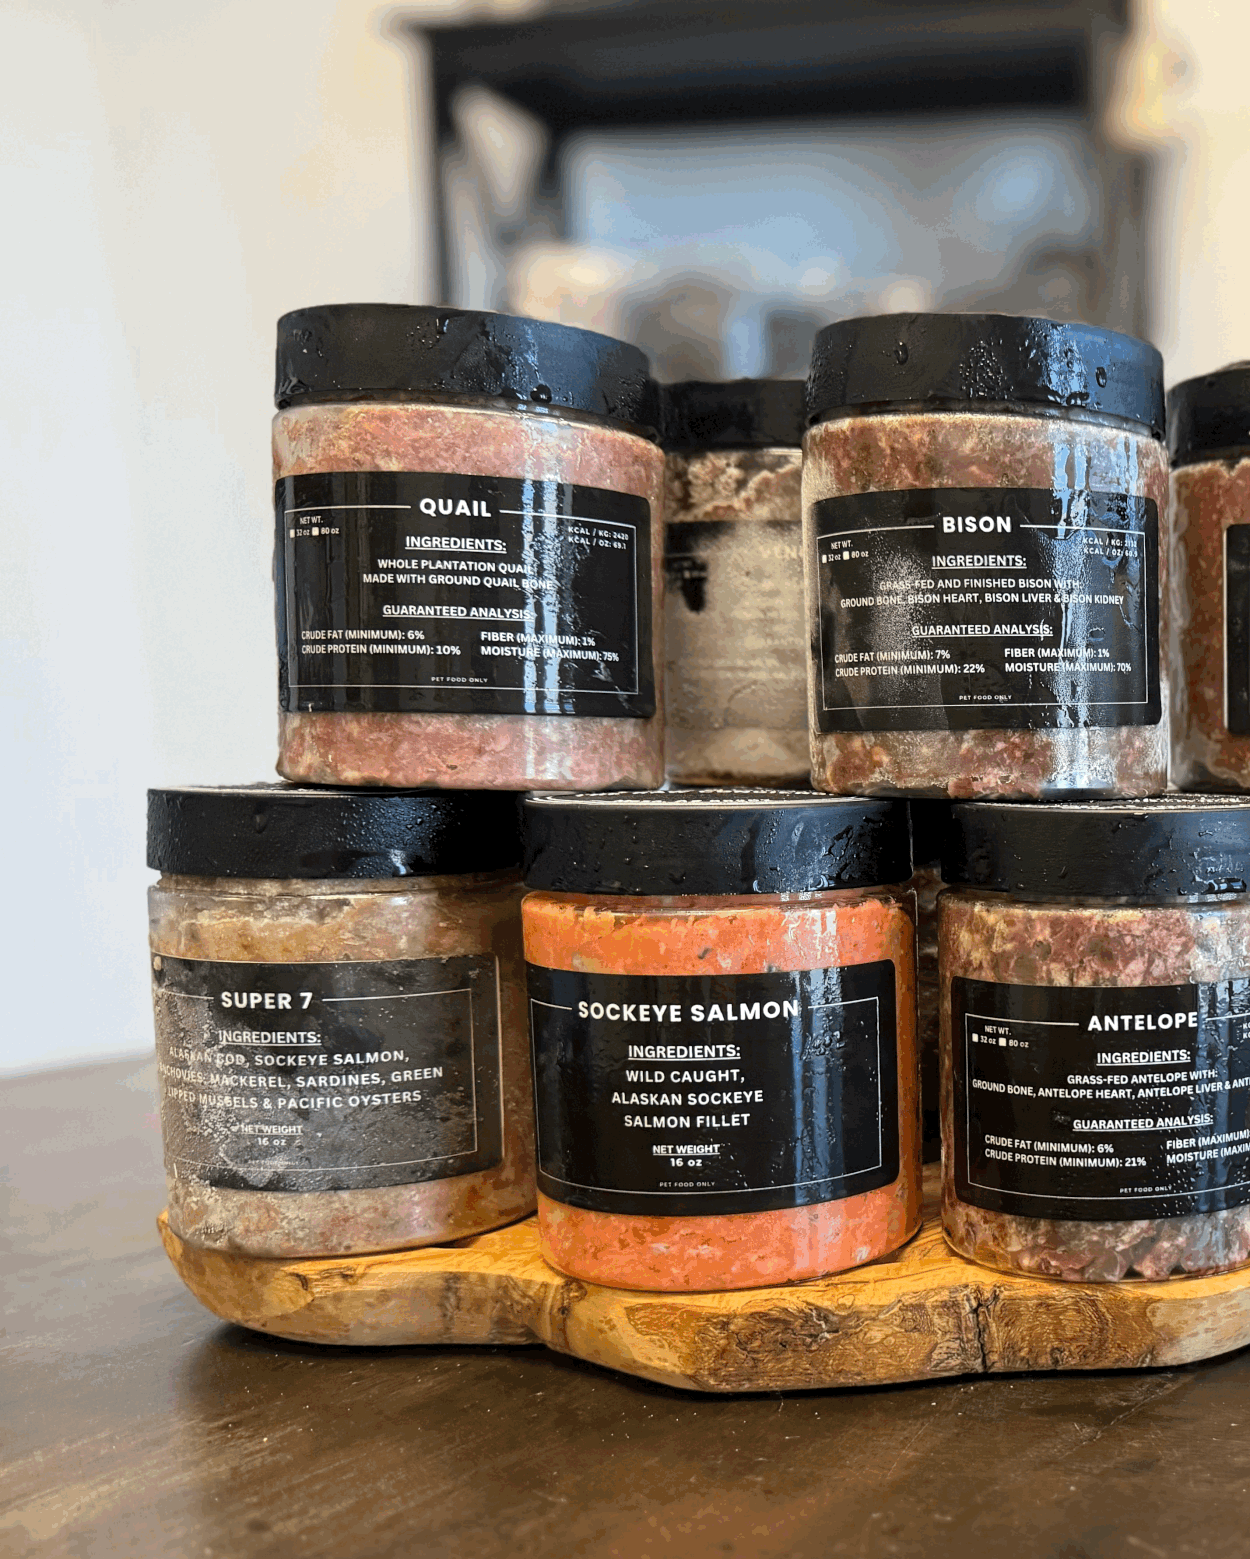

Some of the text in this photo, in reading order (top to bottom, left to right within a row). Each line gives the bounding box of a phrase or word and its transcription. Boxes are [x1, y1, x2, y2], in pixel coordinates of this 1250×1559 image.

[419, 499, 491, 517] QUAIL
[943, 517, 1011, 533] BISON
[405, 536, 506, 551] INGREDIENTS:
[378, 559, 418, 570] WHOLE
[421, 560, 495, 572] PLANTATION
[932, 555, 1026, 567] INGREDIENTS:
[363, 574, 395, 584] MADE
[398, 574, 426, 585] WITH
[428, 575, 480, 586] GROUND
[483, 576, 519, 588] QUAIL
[383, 605, 467, 617] GUARANTEED
[302, 629, 424, 640] CRUDE FAT (MINIMUM): 6%
[912, 624, 1053, 635] GUARANTEED ANALYSIS:
[835, 664, 985, 677] CRUDE PROTEIN (MINIMUM): 22%
[221, 991, 313, 1009] SUPER 7
[578, 1000, 799, 1023] SOCKEYE SALMON
[1088, 1012, 1198, 1032] ANTELOPE
[218, 1030, 321, 1043] INGREDIENTS:
[628, 1044, 740, 1058] INGREDIENTS:
[1097, 1050, 1190, 1064] INGREDIENTS:
[210, 1067, 443, 1088] MACKEREL, SARDINES, GREEN
[626, 1069, 745, 1083] WILD CAUGHT,
[1067, 1068, 1218, 1085] GRASS-FED ANTELOPE WITH:
[972, 1079, 1005, 1093] GROUND
[1007, 1082, 1035, 1098] BONE,
[1038, 1087, 1093, 1099] ANTELOPE
[1095, 1087, 1135, 1100] HEART,
[1137, 1084, 1194, 1098] ANTELOPE
[1196, 1081, 1222, 1094] LIVER
[1224, 1079, 1231, 1091] &
[263, 1097, 271, 1108] &
[612, 1090, 763, 1106] ALASKAN SOCKEYE
[624, 1114, 750, 1128] SALMON FILLET
[1073, 1114, 1213, 1130] GUARANTEED ANALYSIS:
[653, 1144, 719, 1154] NET WEIGHT
[985, 1135, 1114, 1154] CRUDE FAT (MINIMUM): 6%
[670, 1158, 683, 1166] 16
[985, 1148, 1146, 1168] CRUDE PROTEIN (MINIMUM): 21%
